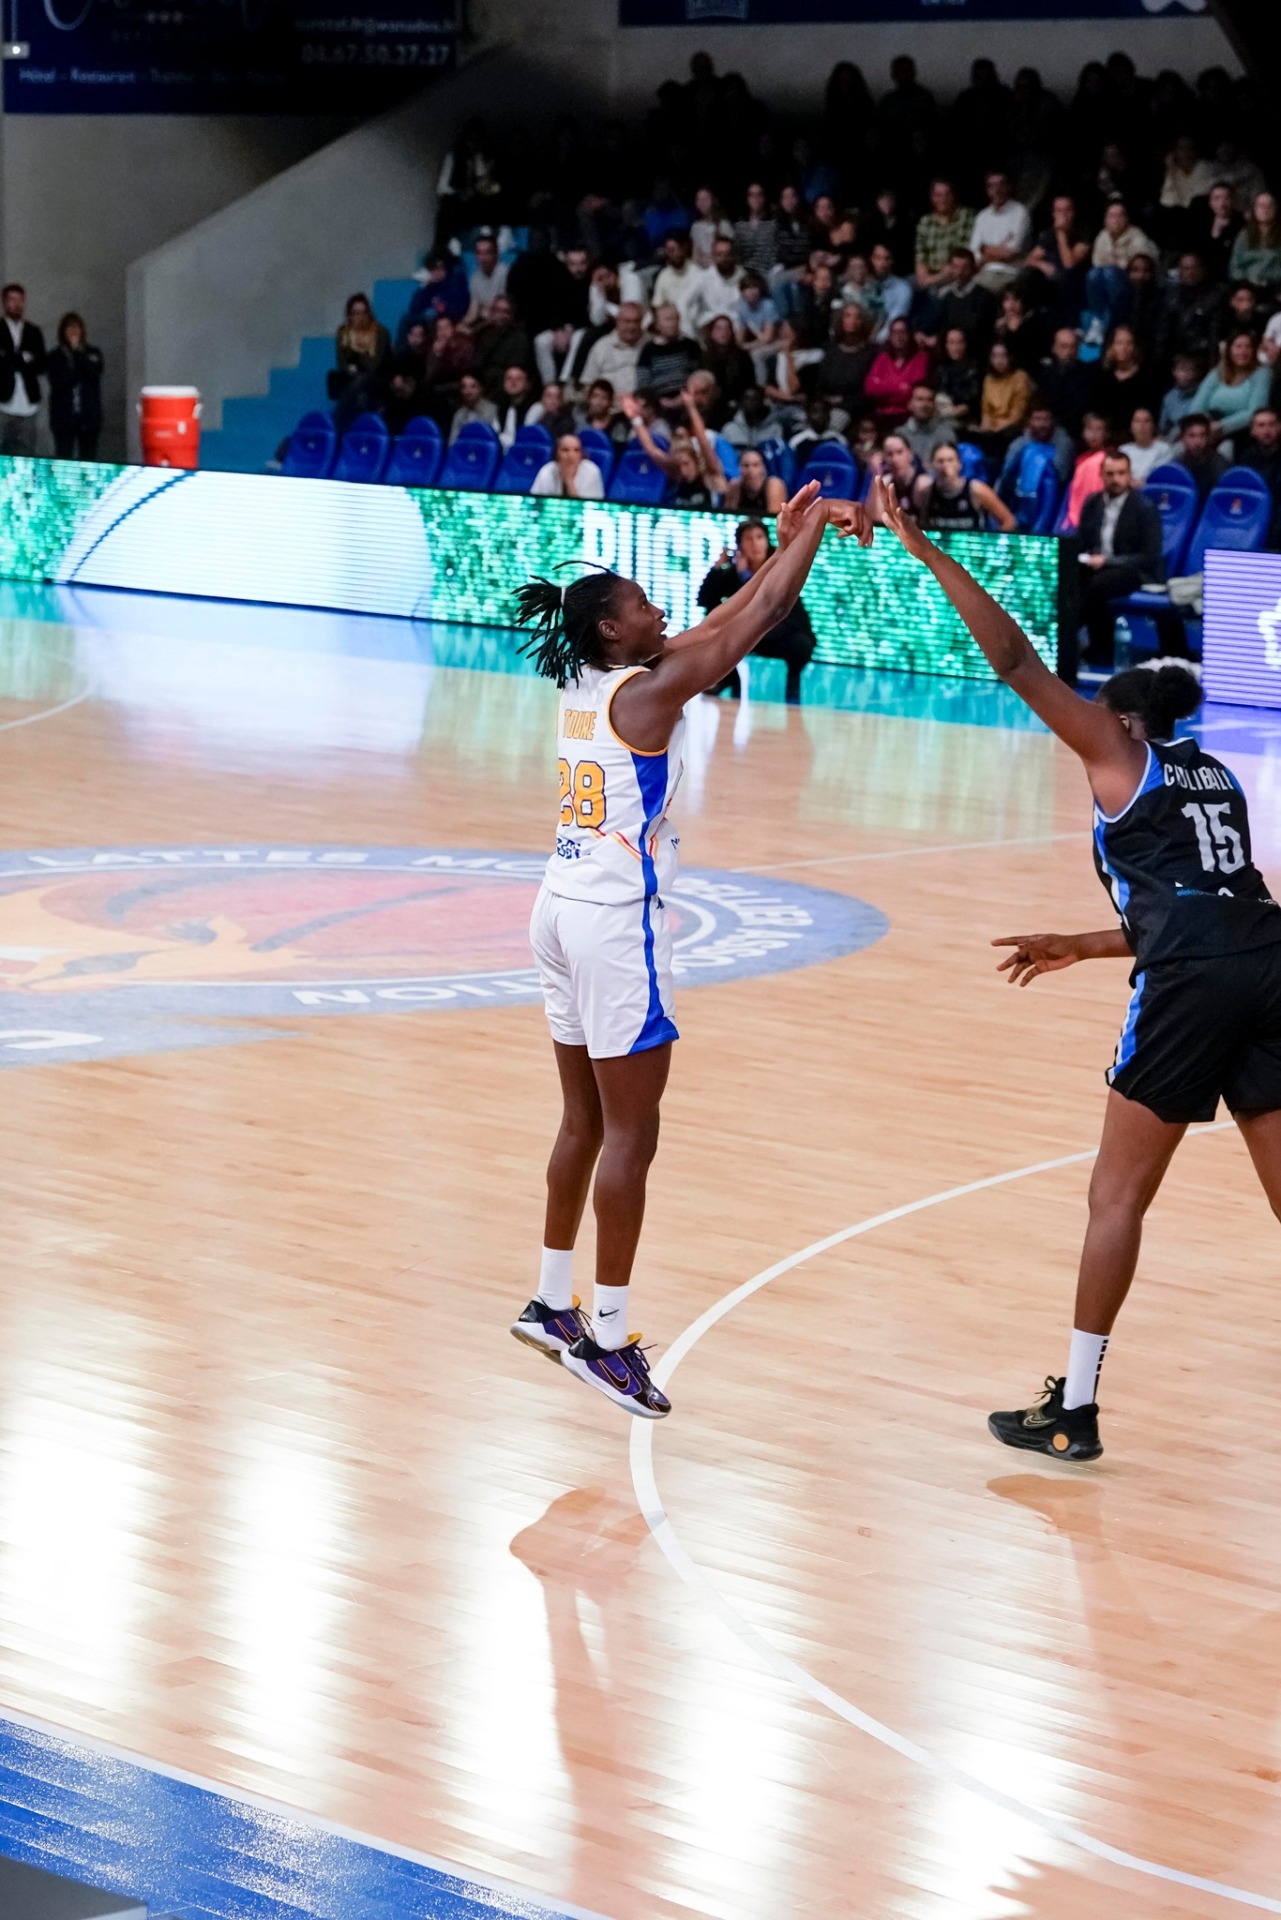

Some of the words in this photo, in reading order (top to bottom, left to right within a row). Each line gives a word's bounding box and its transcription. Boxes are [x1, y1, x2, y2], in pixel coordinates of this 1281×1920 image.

[558, 757, 607, 830] 28
[28, 850, 370, 867] LATTES
[1181, 802, 1246, 875] 15
